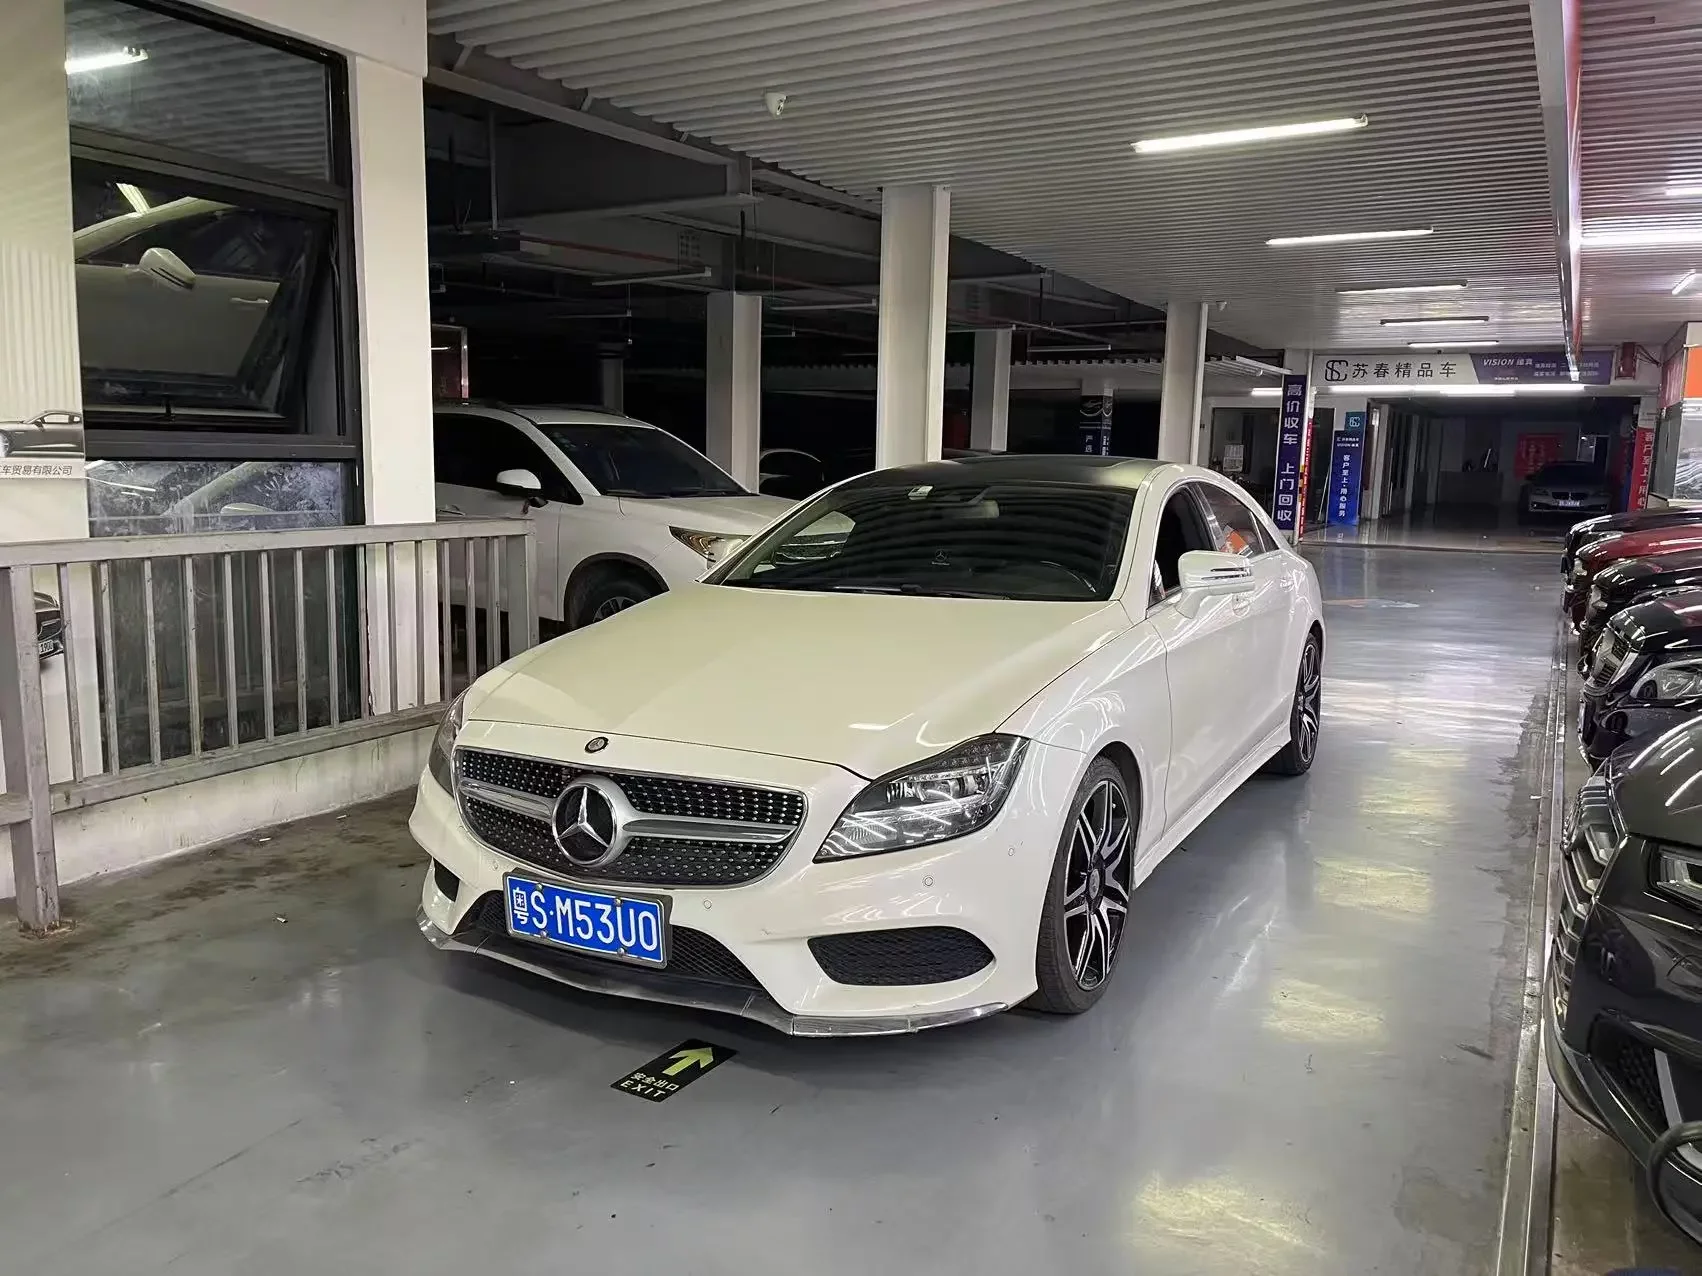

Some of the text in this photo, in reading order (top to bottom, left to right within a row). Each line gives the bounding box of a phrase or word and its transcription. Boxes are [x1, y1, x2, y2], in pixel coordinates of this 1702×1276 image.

[1352, 362, 1457, 379] 苏春精品车
[1277, 384, 1303, 521] 高价收车 上门回收
[620, 1080, 667, 1098] EXIT
[630, 1072, 680, 1092] 安全出口
